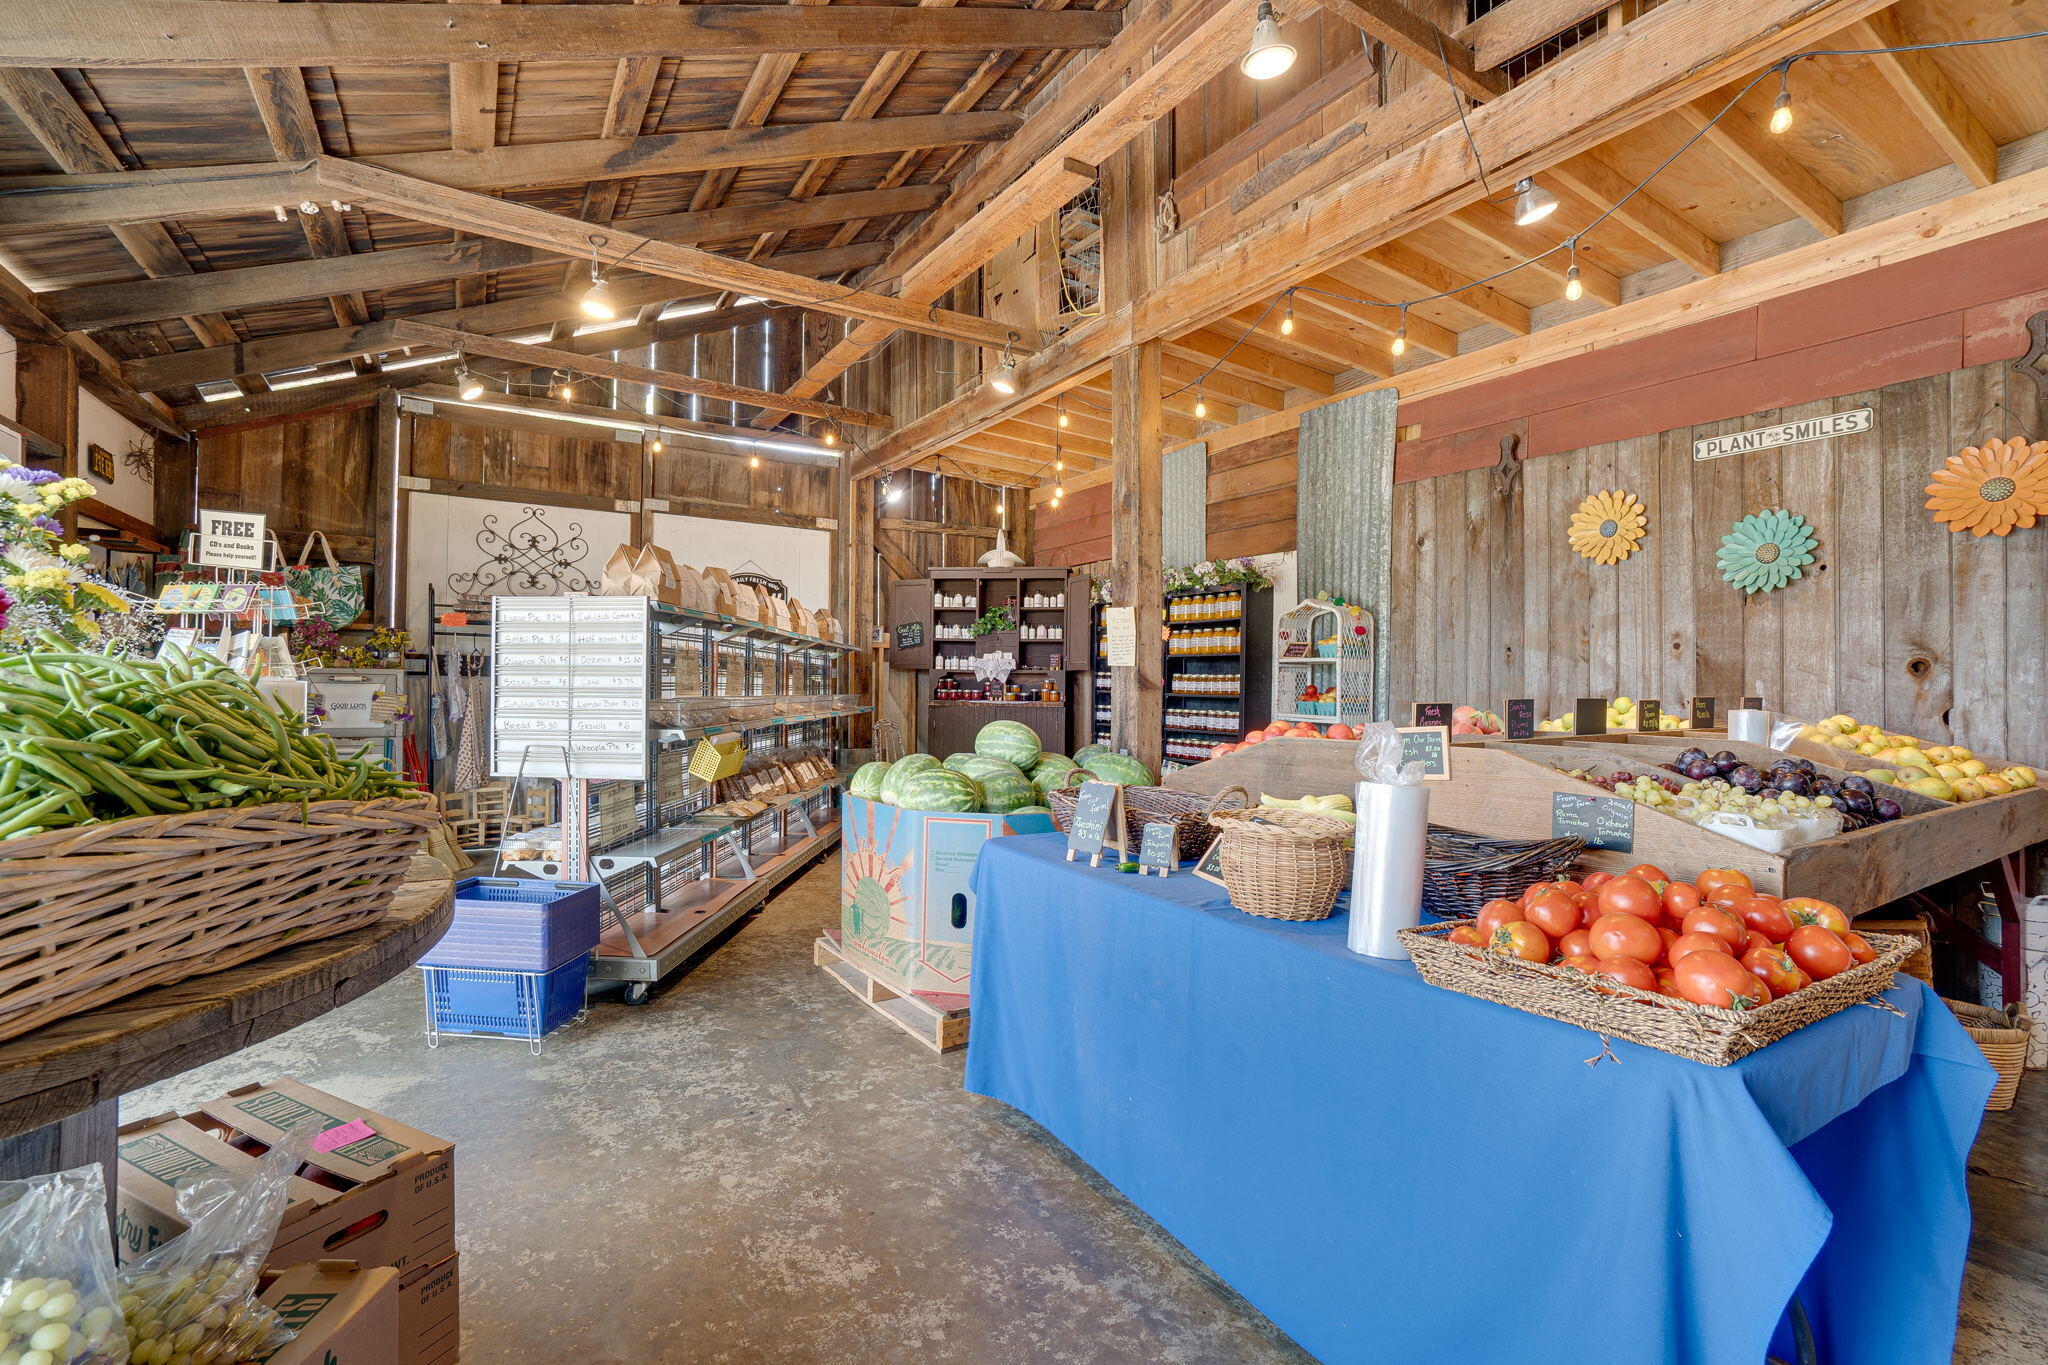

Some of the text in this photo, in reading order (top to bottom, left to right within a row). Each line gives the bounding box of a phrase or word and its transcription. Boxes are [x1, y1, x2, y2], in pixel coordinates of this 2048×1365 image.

[1706, 414, 1859, 456] PLANT SMILES
[211, 519, 255, 538] FREE
[209, 540, 222, 548] CD's
[236, 543, 255, 551] Books
[222, 551, 234, 559] help
[235, 553, 257, 561] yourself!
[749, 576, 768, 586] FRESH
[504, 634, 561, 644] Small Pie $6
[578, 635, 595, 644] Half
[1087, 797, 1099, 805] our
[1556, 794, 1578, 803] From
[1089, 798, 1110, 814] farm!
[1555, 808, 1579, 819] Roma
[1075, 816, 1104, 831] Zucchini
[1557, 817, 1591, 828] Tomatoes
[1596, 816, 1630, 829] Oxheart
[1077, 828, 1087, 840] $3
[1596, 826, 1632, 839] Tomatoes
[1593, 836, 1605, 845] lb
[414, 1161, 449, 1184] PRODUCE
[414, 1173, 449, 1194] OF U.S.A.
[420, 1267, 454, 1295] PRODUCE
[420, 1294, 431, 1305] OF
